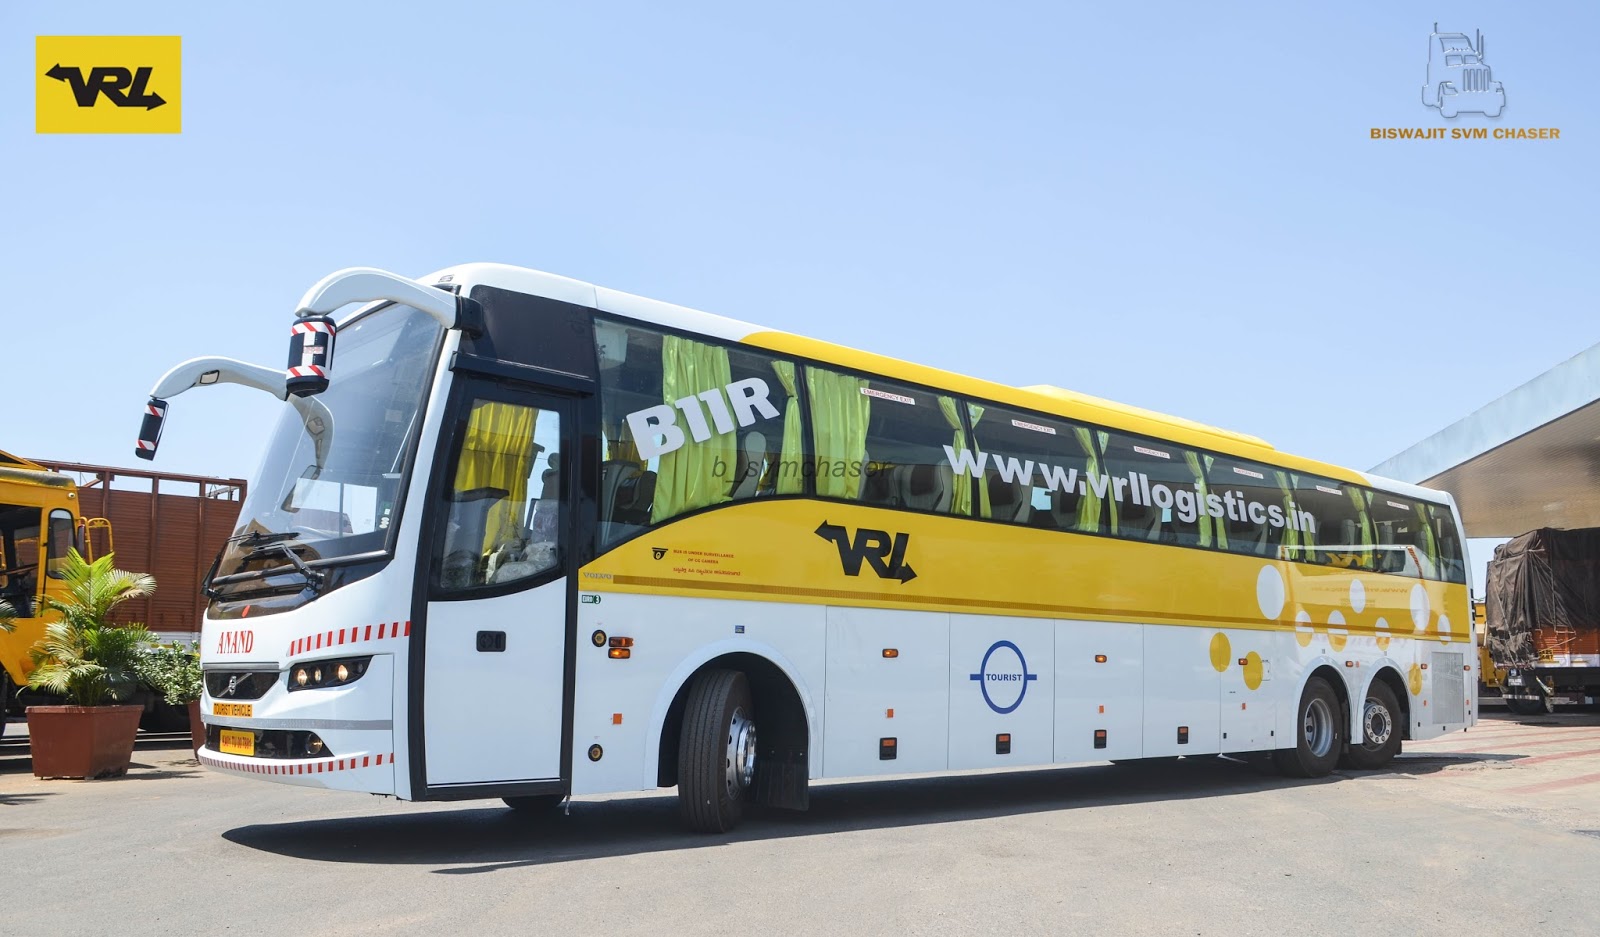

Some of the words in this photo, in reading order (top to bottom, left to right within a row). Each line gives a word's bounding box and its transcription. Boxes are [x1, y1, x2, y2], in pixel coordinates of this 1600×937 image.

[625, 377, 781, 461] B11R
[814, 519, 918, 585] VRL
[583, 572, 612, 580] VOLVO
[216, 630, 254, 654] ANAND
[214, 703, 230, 716] TOURIST
[230, 704, 252, 717] VEHICLE
